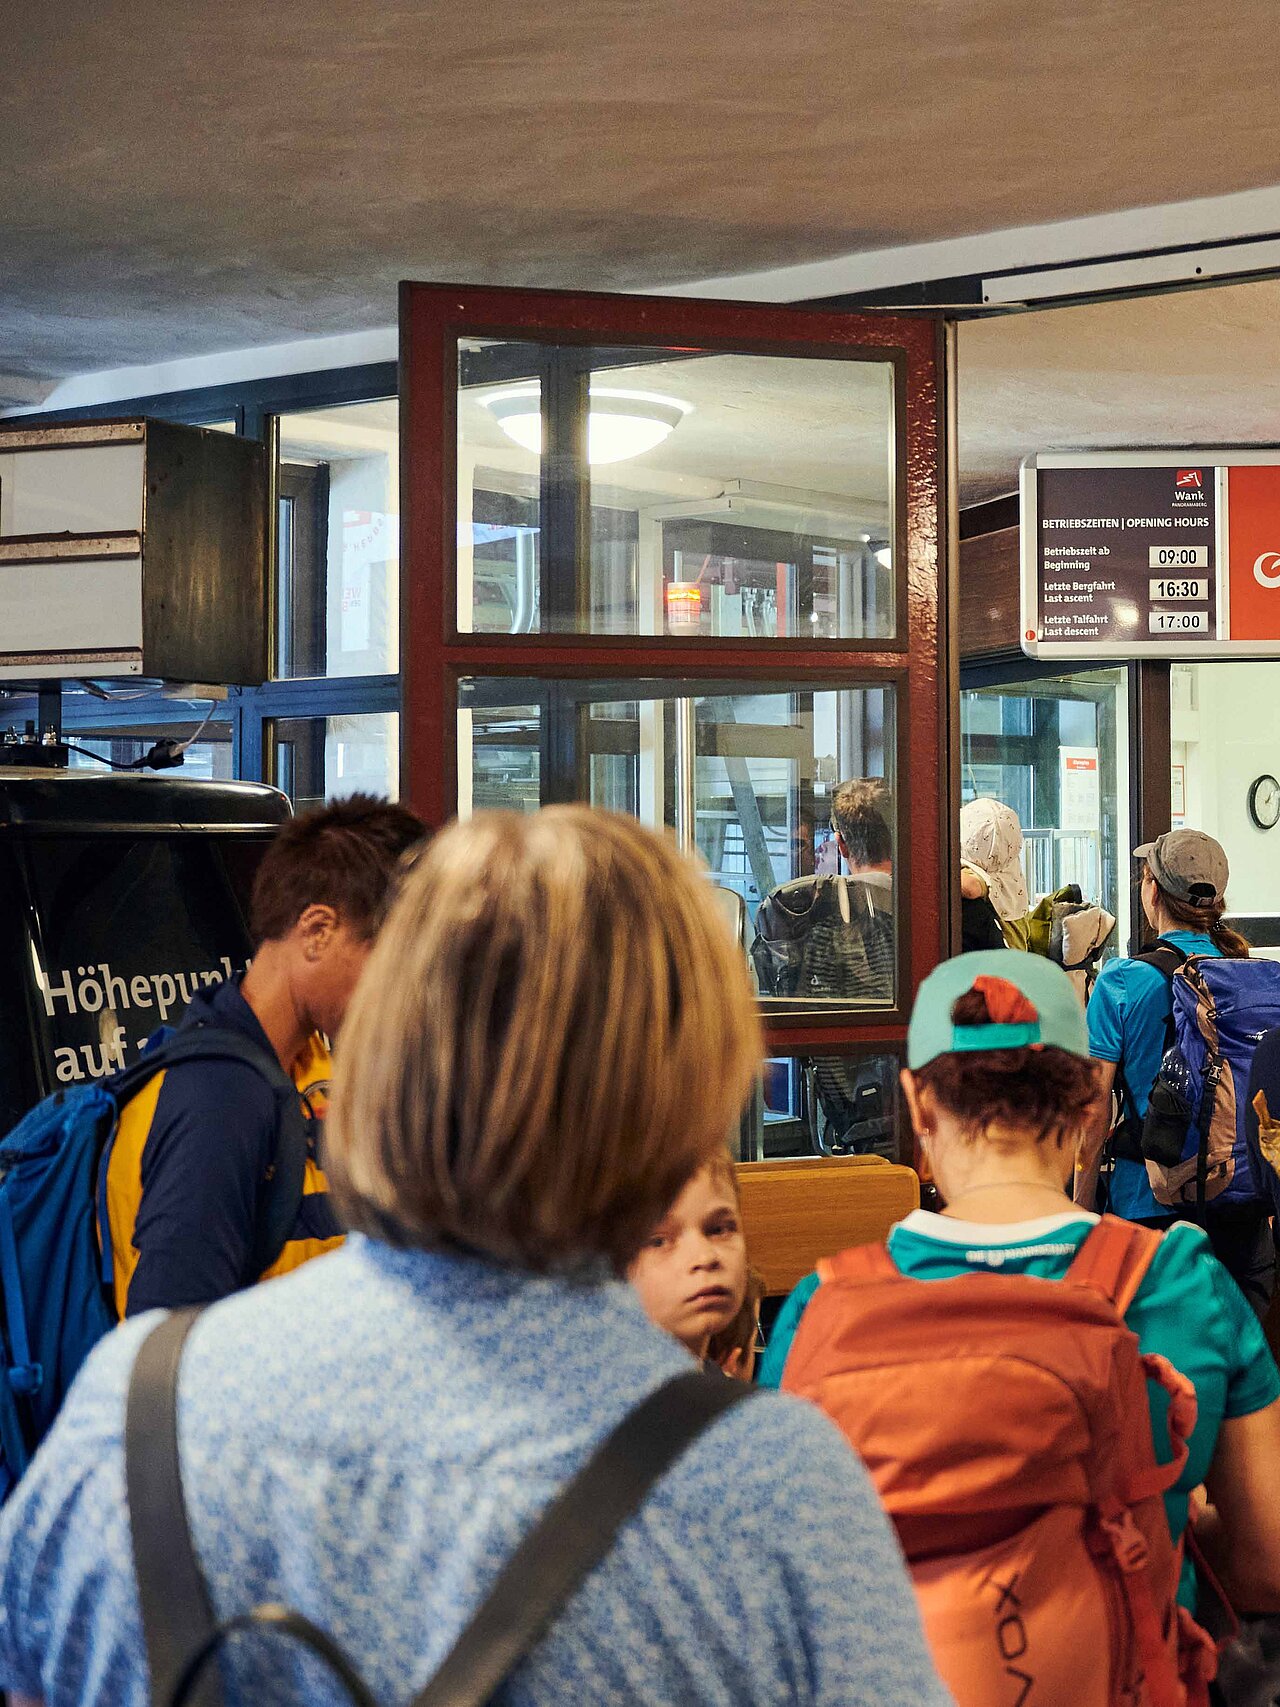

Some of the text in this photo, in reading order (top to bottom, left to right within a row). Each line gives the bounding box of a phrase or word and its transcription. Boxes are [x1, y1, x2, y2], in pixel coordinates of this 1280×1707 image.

[1175, 491, 1204, 501] Wank
[1042, 518, 1119, 529] BETRIEBSZEITEN
[1126, 517, 1172, 528] OPENING
[1174, 517, 1209, 527] HOURS
[1044, 546, 1110, 556] Betriebszeit ab
[1159, 549, 1197, 565] 09:00
[1044, 560, 1090, 571] Beginning
[1044, 581, 1115, 593] Letzte Bergfahrt
[1158, 581, 1199, 597] 16:30
[1044, 594, 1093, 603] Last ascent
[1044, 614, 1109, 624] Letzte Talfahrt
[1158, 615, 1200, 629] 17:00
[1044, 627, 1062, 636] Last
[1064, 627, 1099, 636] descent
[54, 1027, 127, 1082] auf
